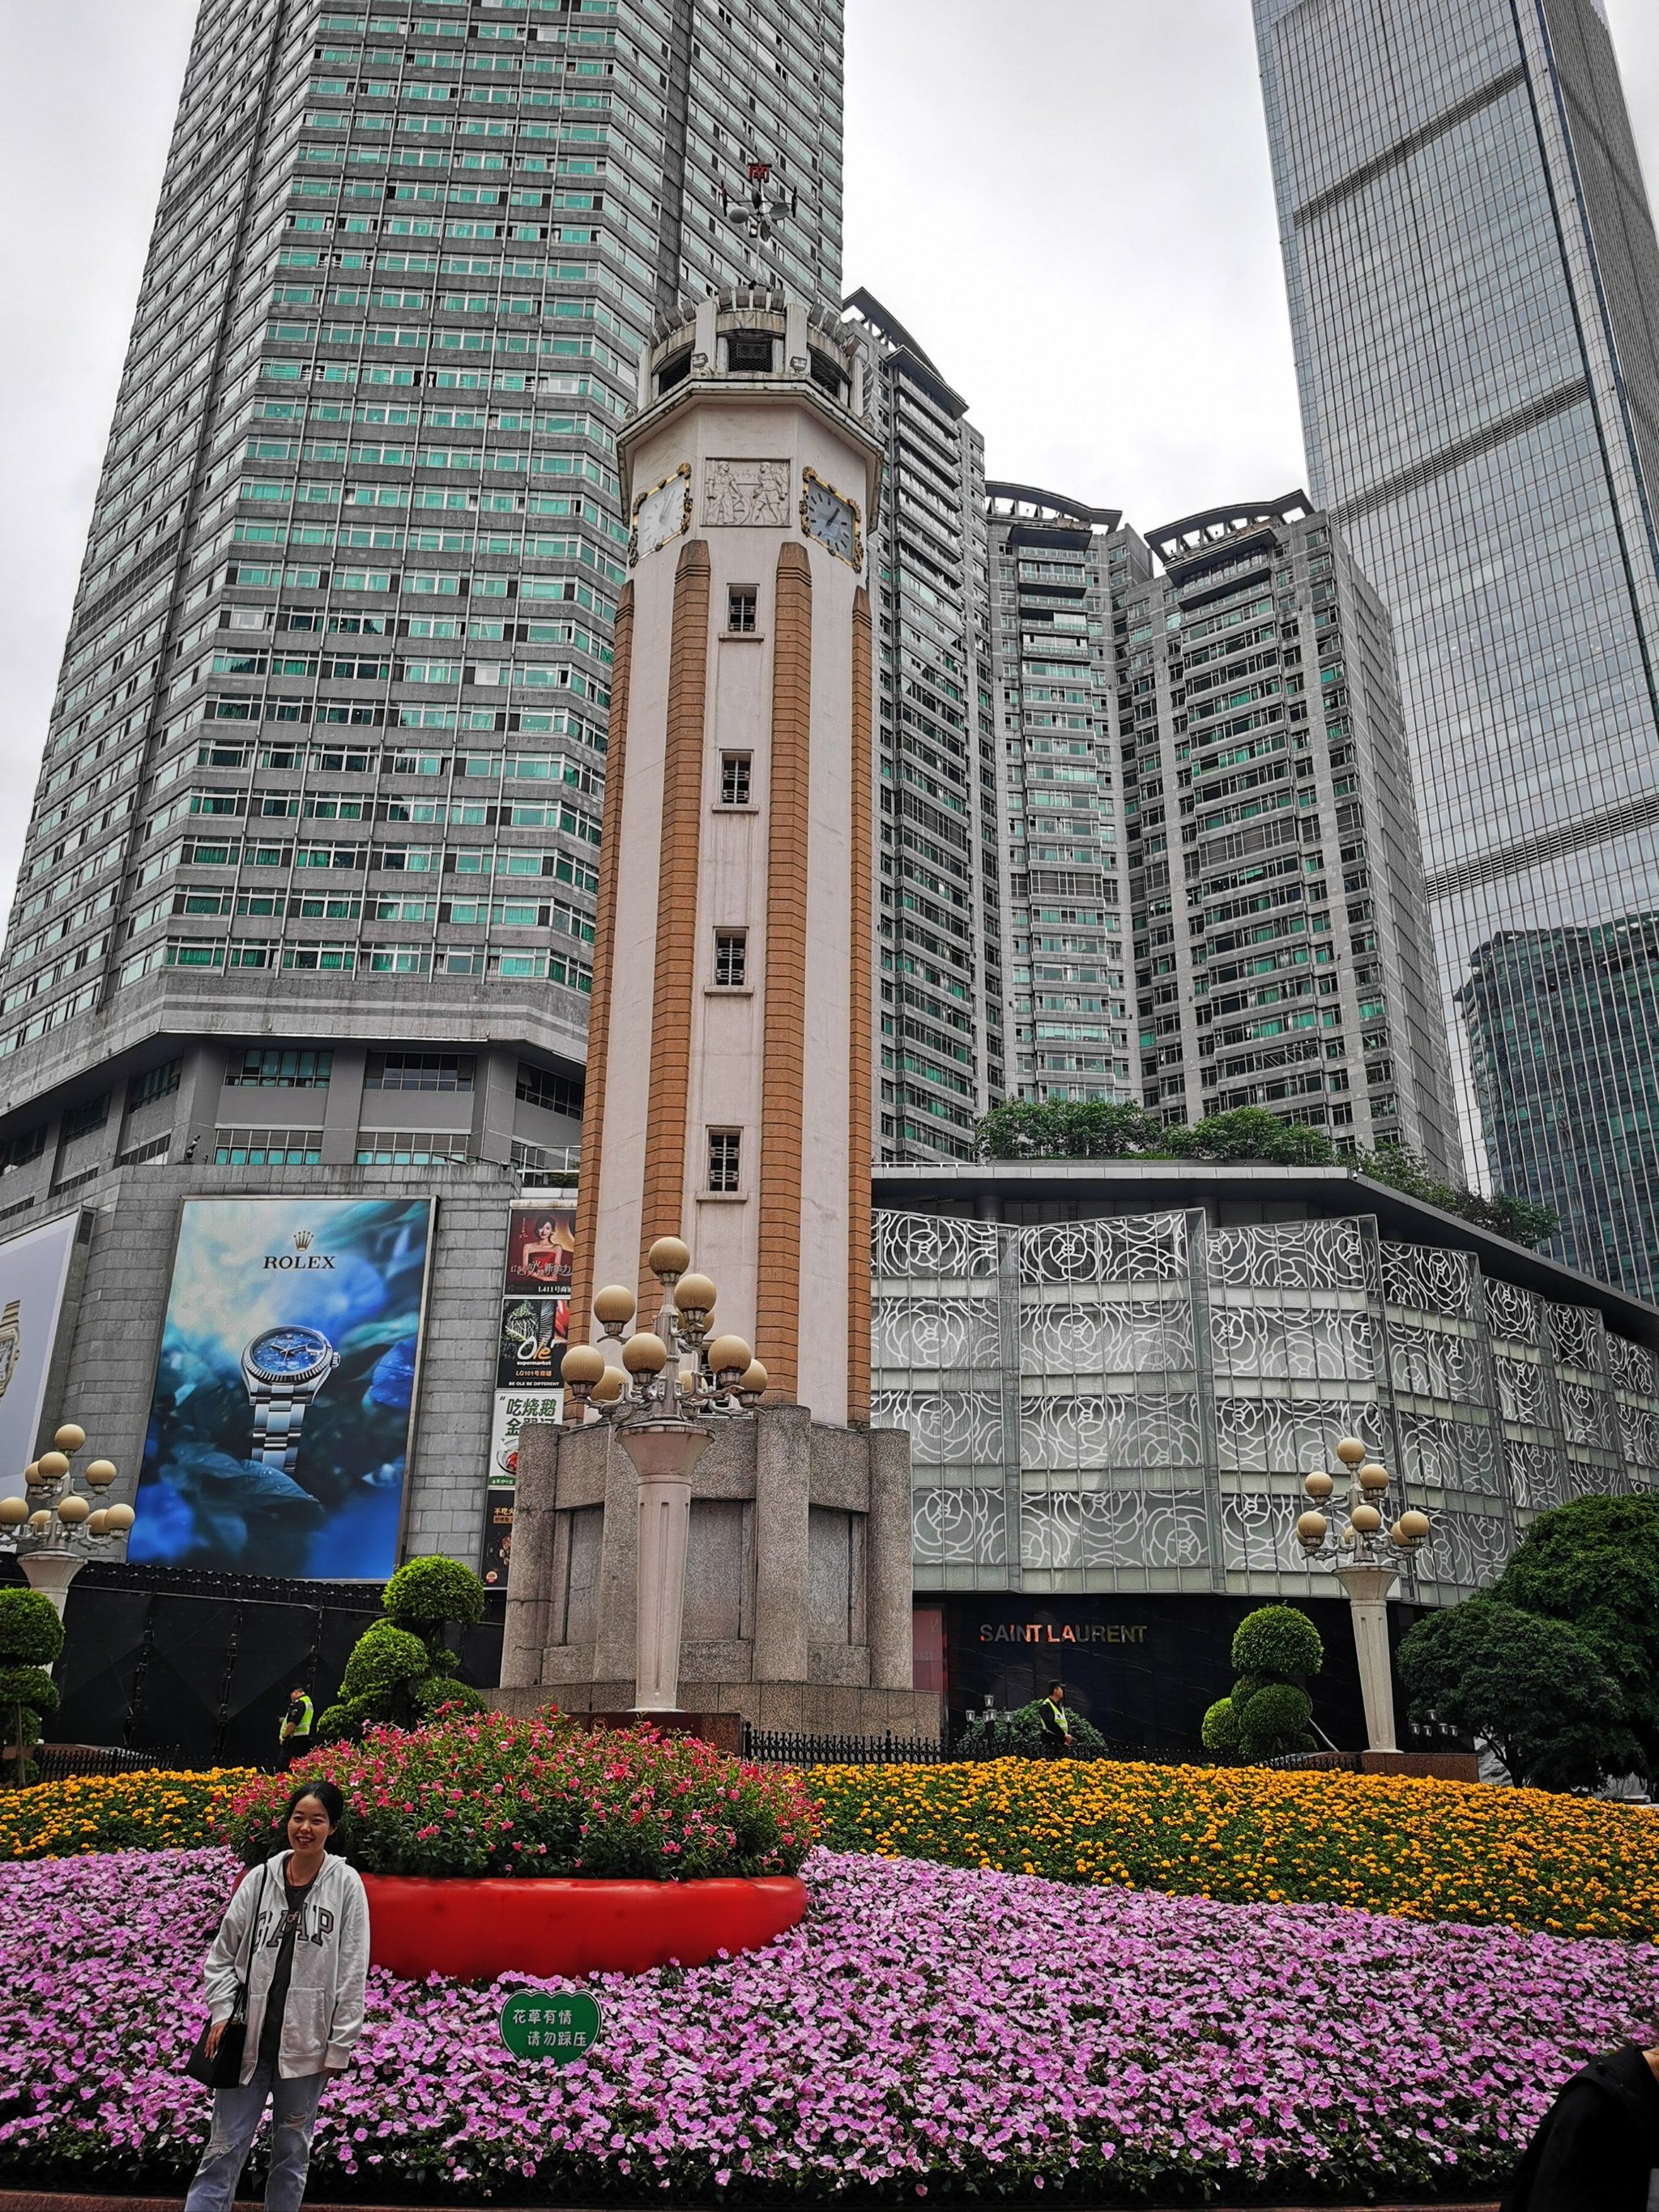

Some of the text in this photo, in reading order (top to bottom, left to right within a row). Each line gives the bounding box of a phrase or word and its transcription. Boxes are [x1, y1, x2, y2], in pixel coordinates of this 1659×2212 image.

[263, 1255, 335, 1269] ROLEX
[979, 1624, 1147, 1643] SAINT LAURENT
[253, 1903, 334, 1954] GAP
[512, 2009, 573, 2025] 花草有情
[527, 2031, 586, 2047] 请勿踩压
